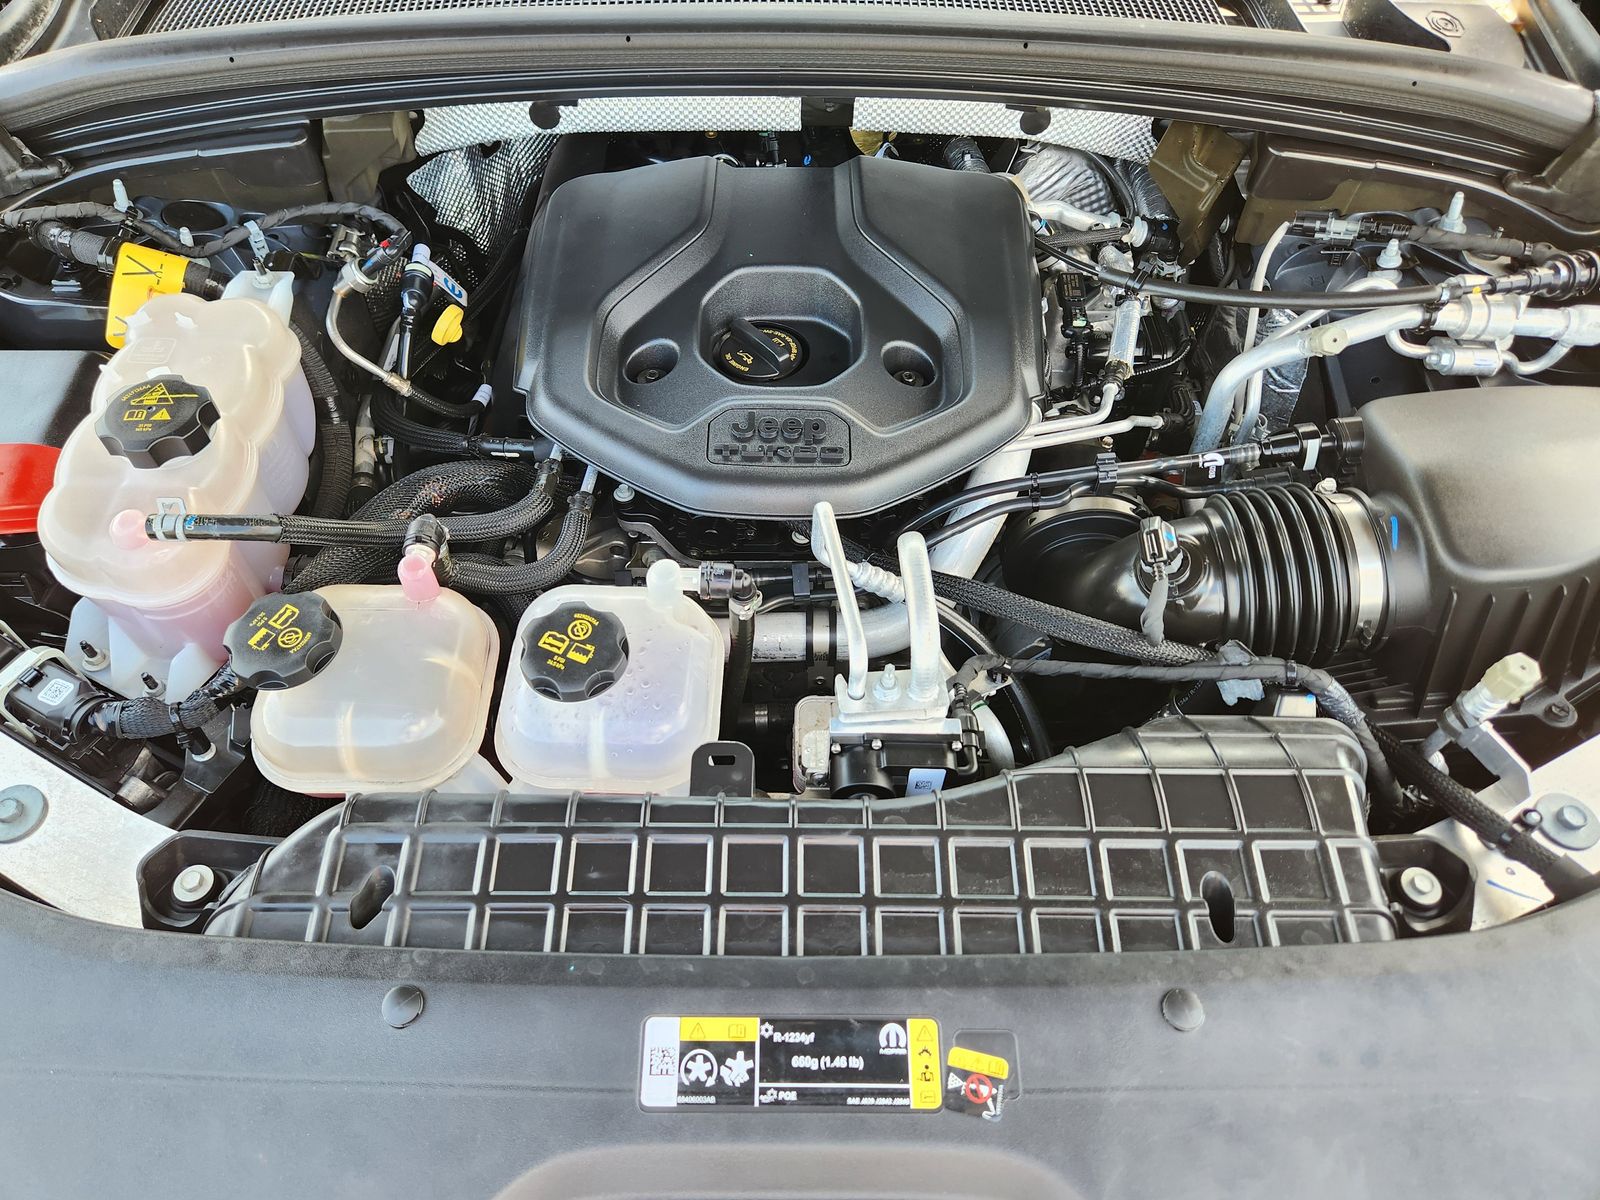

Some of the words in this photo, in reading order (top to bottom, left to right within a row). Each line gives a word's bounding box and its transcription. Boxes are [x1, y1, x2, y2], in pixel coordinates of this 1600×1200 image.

[728, 360, 749, 372] ENGINE
[731, 411, 827, 446] Jeep
[714, 443, 844, 463] TURBO
[773, 1032, 815, 1045] R-1234yf
[791, 1055, 819, 1071] 660g
[820, 1055, 847, 1071] (1.46
[848, 1055, 864, 1071] lb)
